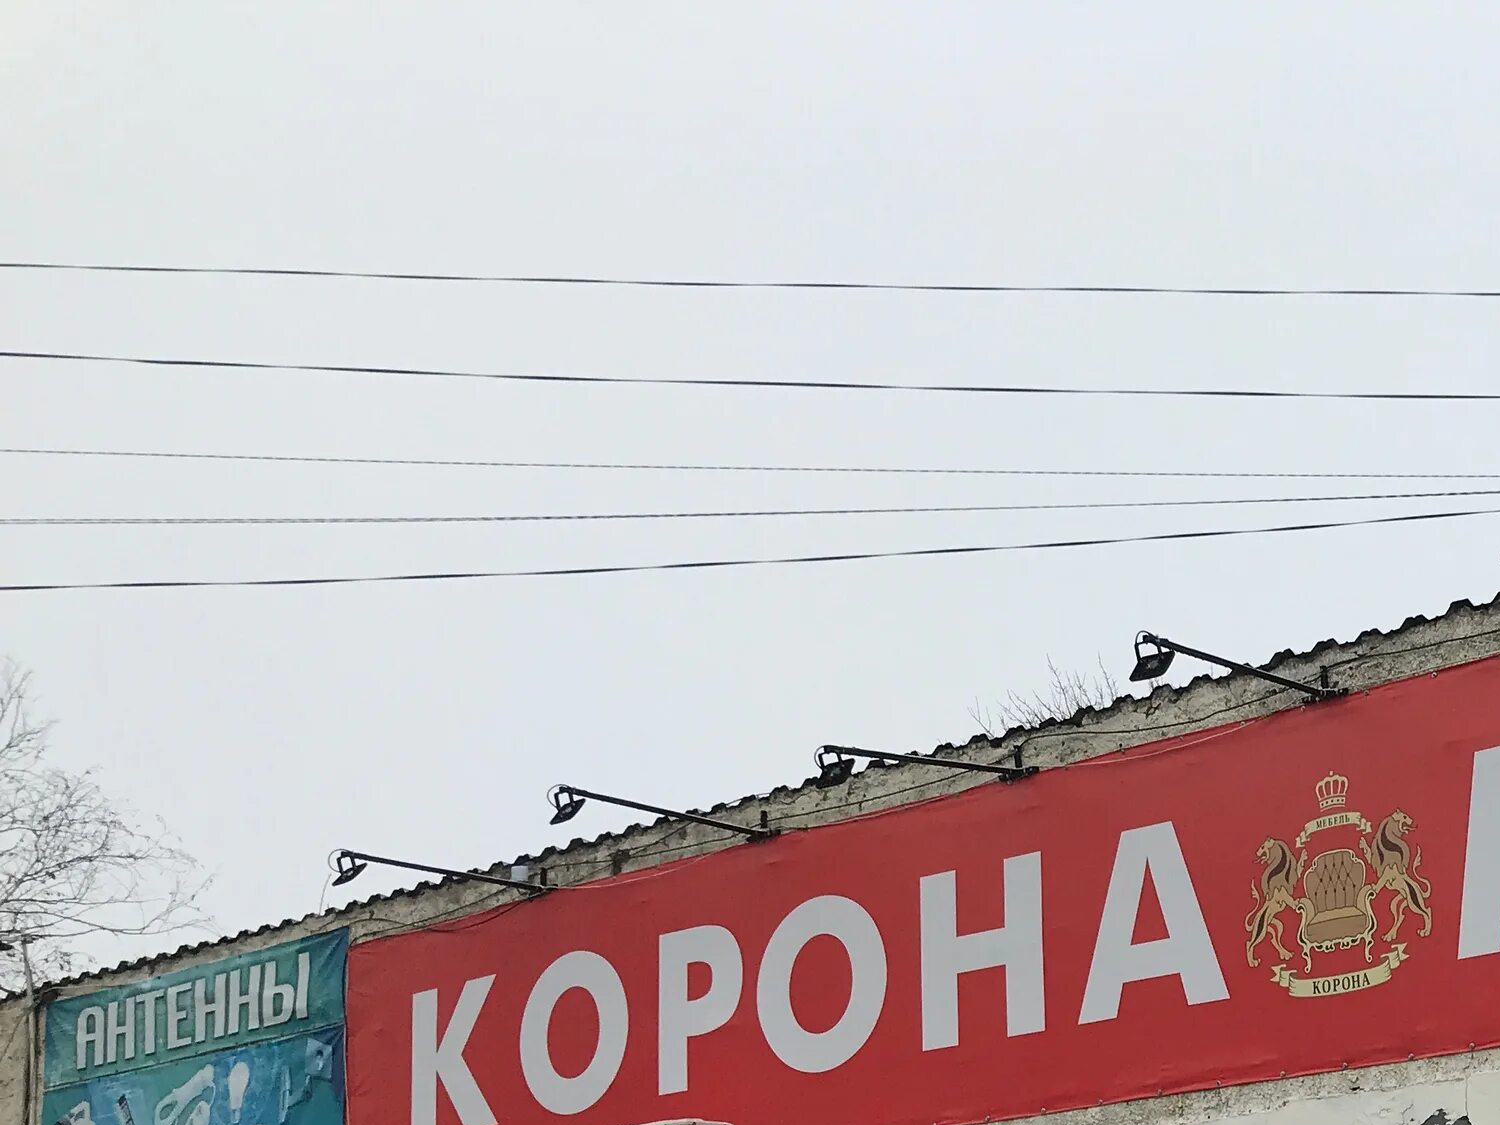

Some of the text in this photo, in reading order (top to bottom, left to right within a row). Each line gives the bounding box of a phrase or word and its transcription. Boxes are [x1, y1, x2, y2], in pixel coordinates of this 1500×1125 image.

[1315, 813, 1351, 830] МЕБЕЛЬ
[1312, 972, 1371, 996] КОРОНА
[75, 952, 311, 1072] АНТЕННЫ
